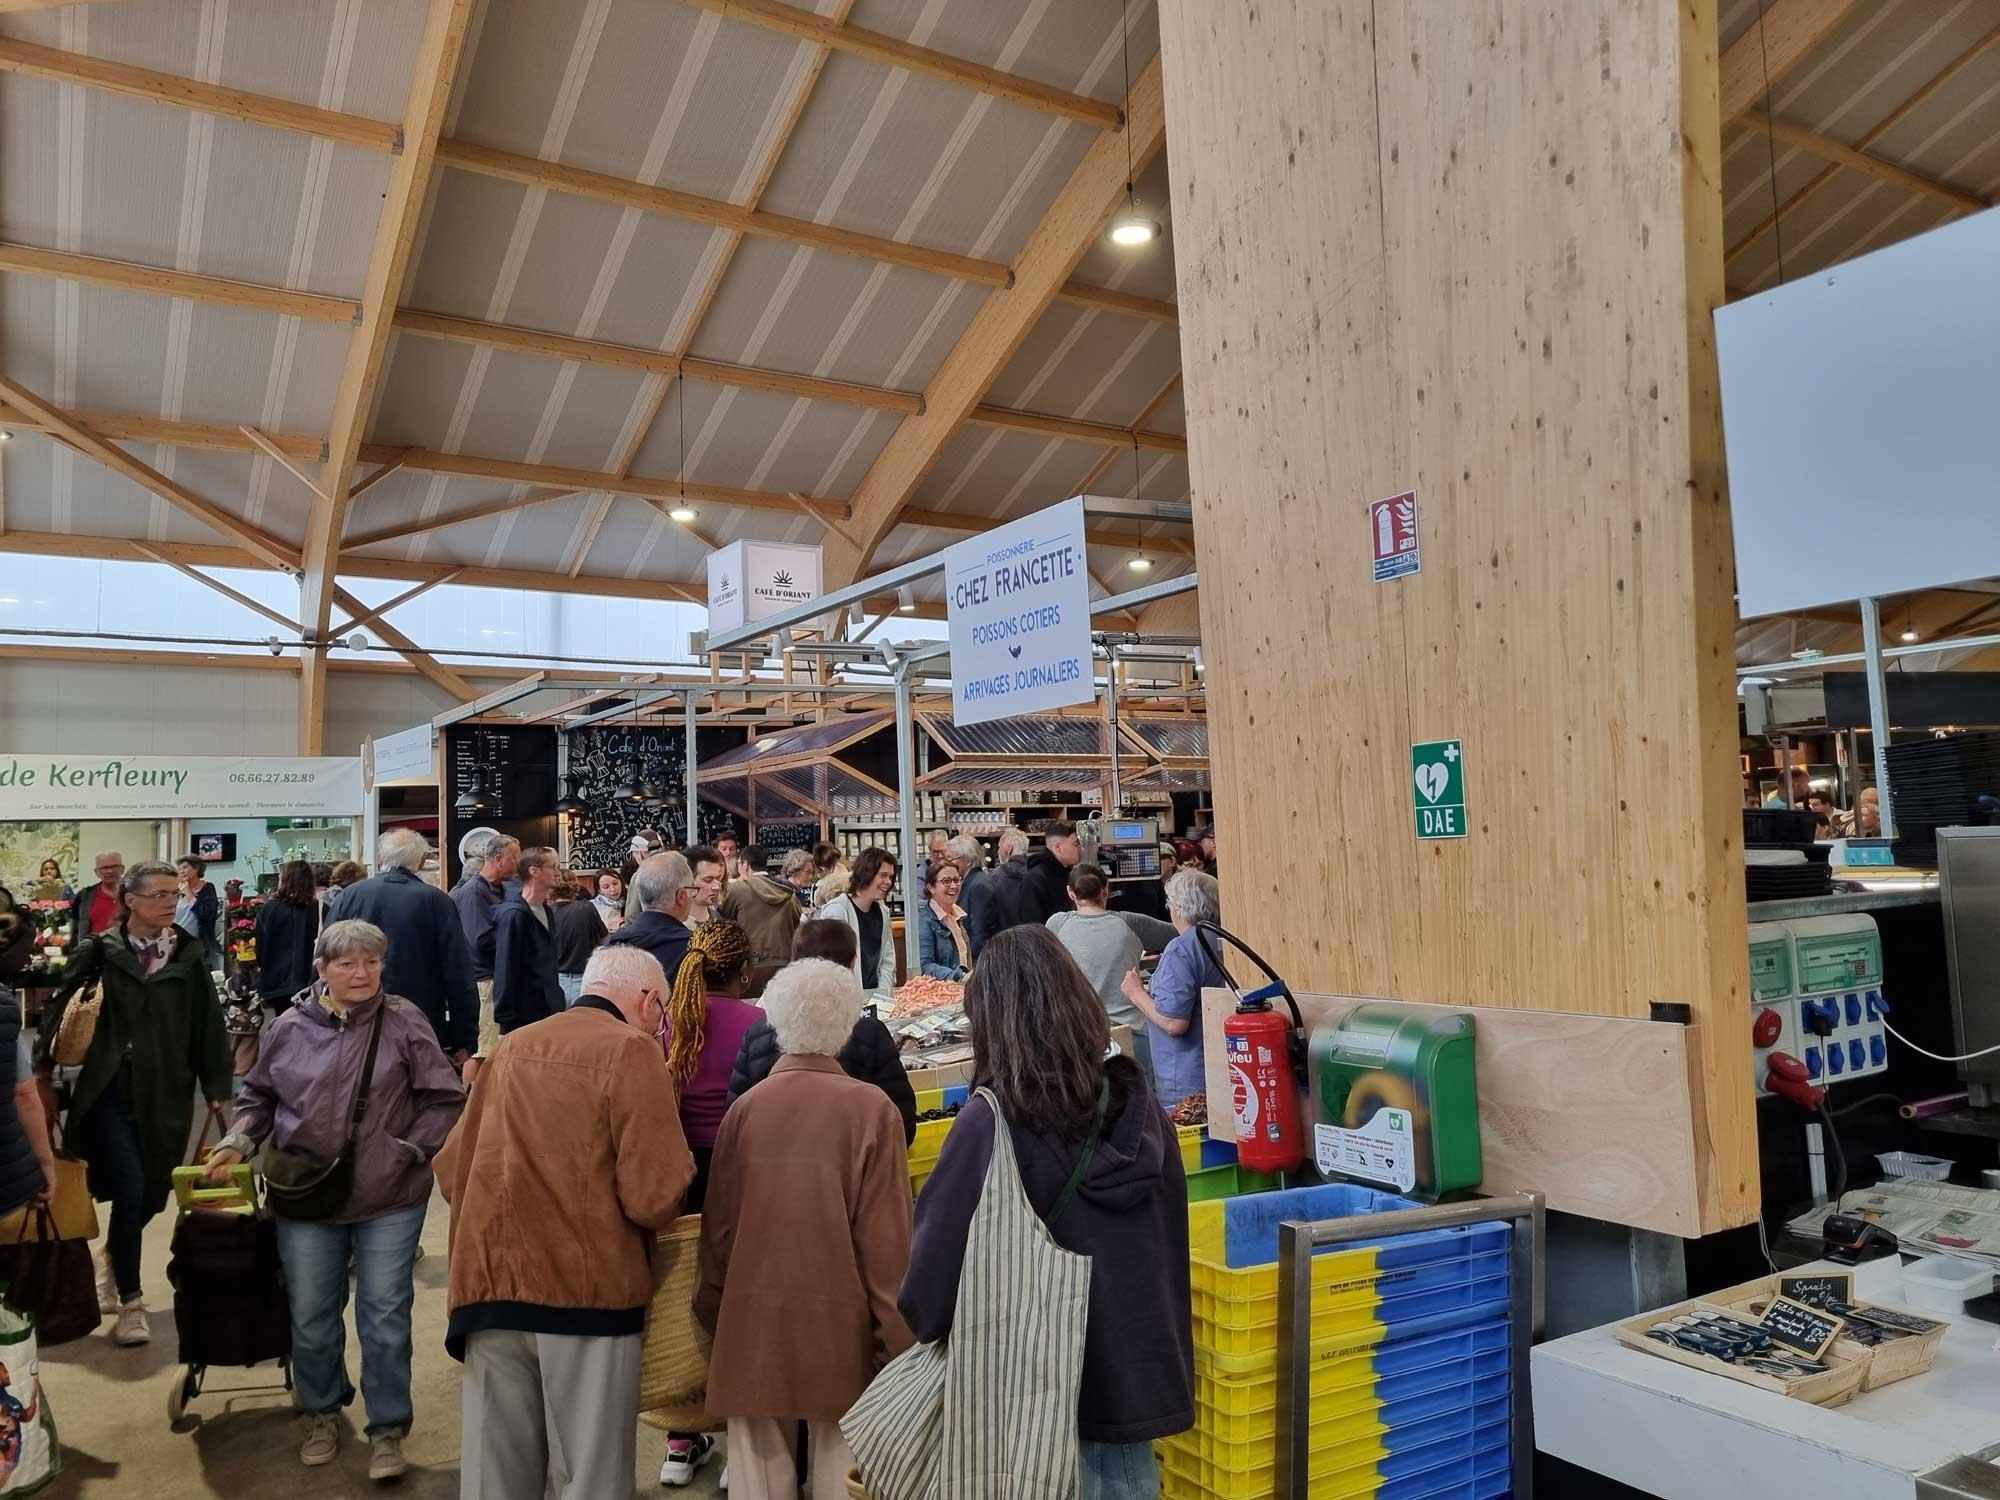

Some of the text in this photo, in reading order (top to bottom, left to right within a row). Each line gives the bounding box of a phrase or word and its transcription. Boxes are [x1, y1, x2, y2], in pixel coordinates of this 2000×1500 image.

[986, 538, 1035, 566] POISSONNERIE
[956, 546, 1074, 610] CHEZ FRANCETTE
[754, 586, 774, 597] CAFÉ
[776, 589, 811, 600] D'ORIANT
[972, 617, 1018, 646] POISSONS
[963, 658, 1080, 702] ARRIVAGES JOURNALIERS
[0, 759, 188, 795] de Kerfleury
[229, 773, 316, 784] 06.66.27.82.89
[1424, 808, 1455, 834] DAE
[600, 851, 632, 862] COMPTO
